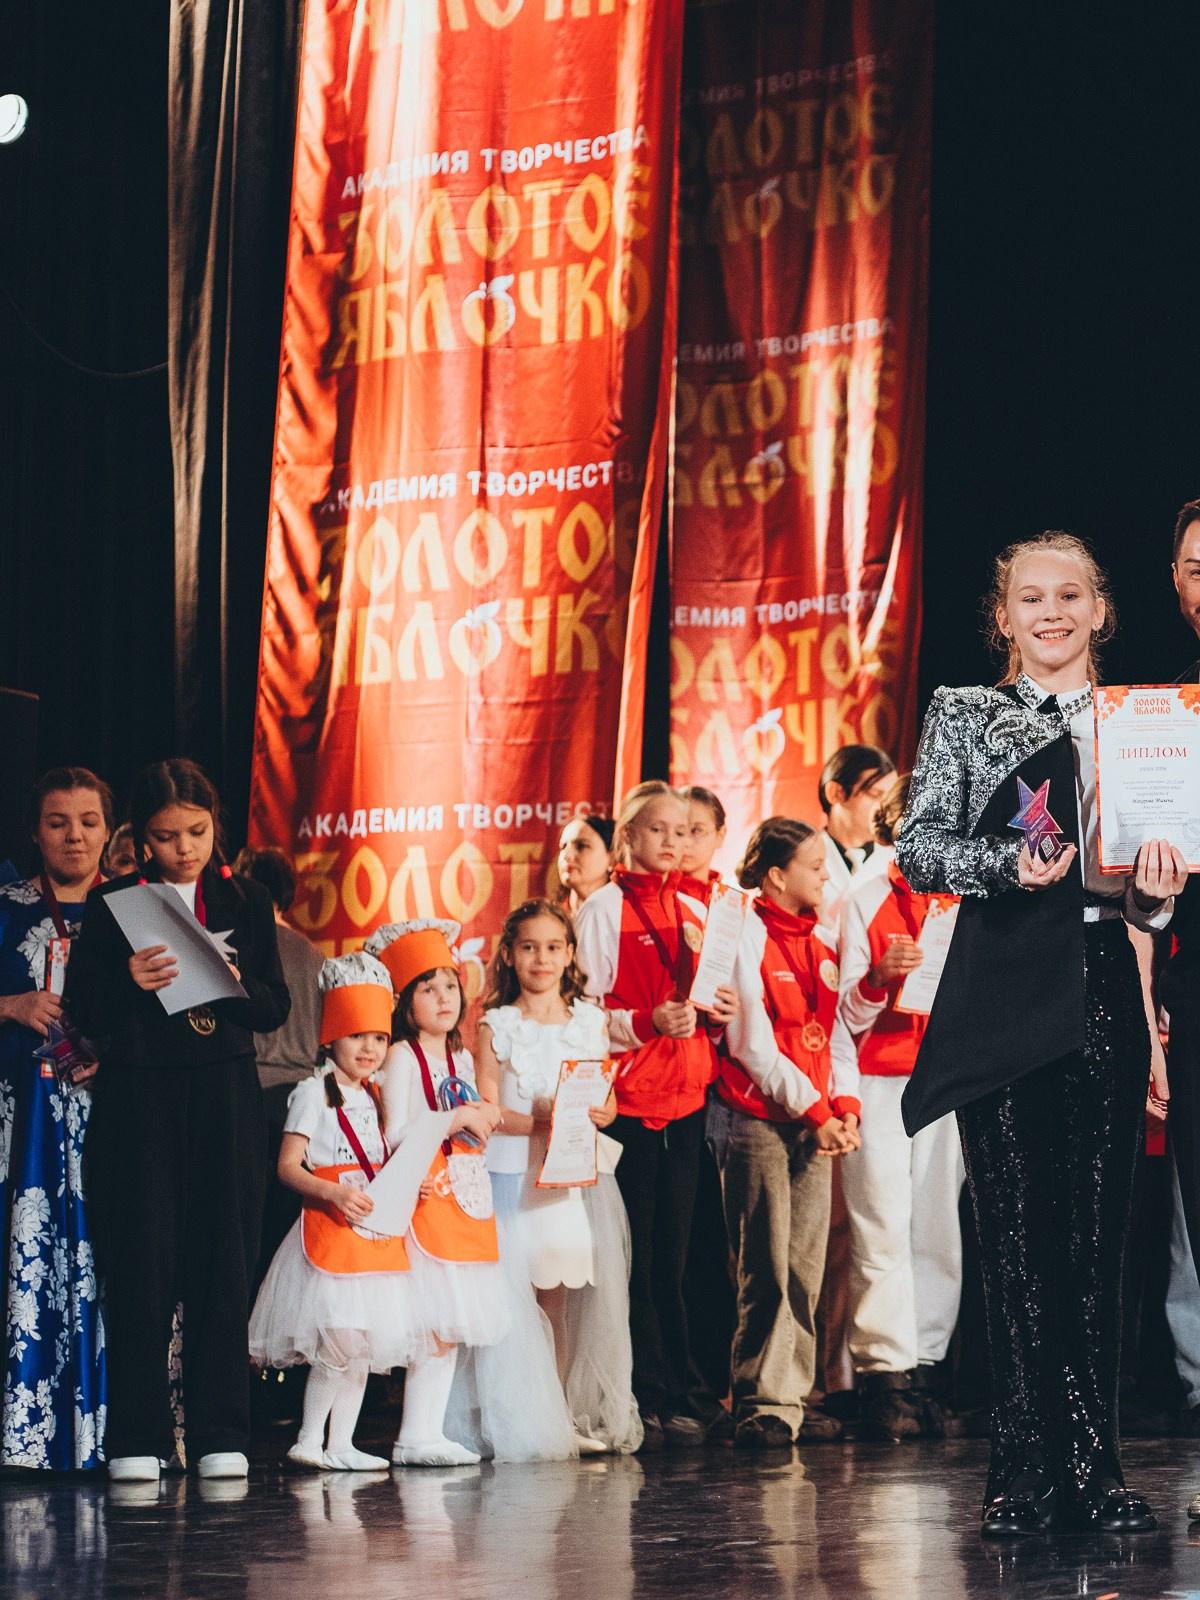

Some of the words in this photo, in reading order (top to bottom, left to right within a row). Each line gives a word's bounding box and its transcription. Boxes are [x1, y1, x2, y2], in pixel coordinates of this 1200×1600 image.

[341, 149, 469, 199] АКАДЕМИЯ
[480, 124, 650, 173] ТВОРЧЕСТВА
[336, 161, 650, 281] ЗОЛОТОЕ
[331, 251, 648, 369] ЯБЛОЧКО
[753, 317, 895, 359] ТВОРЧЕСТВА
[756, 588, 898, 625] ТВОРЧЕСТ
[1133, 697, 1171, 707] ЗОЛОТОЕ
[1133, 706, 1171, 716] ЯБЛОЧКО
[1115, 746, 1187, 761] ДИПЛОМ
[298, 805, 443, 839] АКАДЕМИЯ
